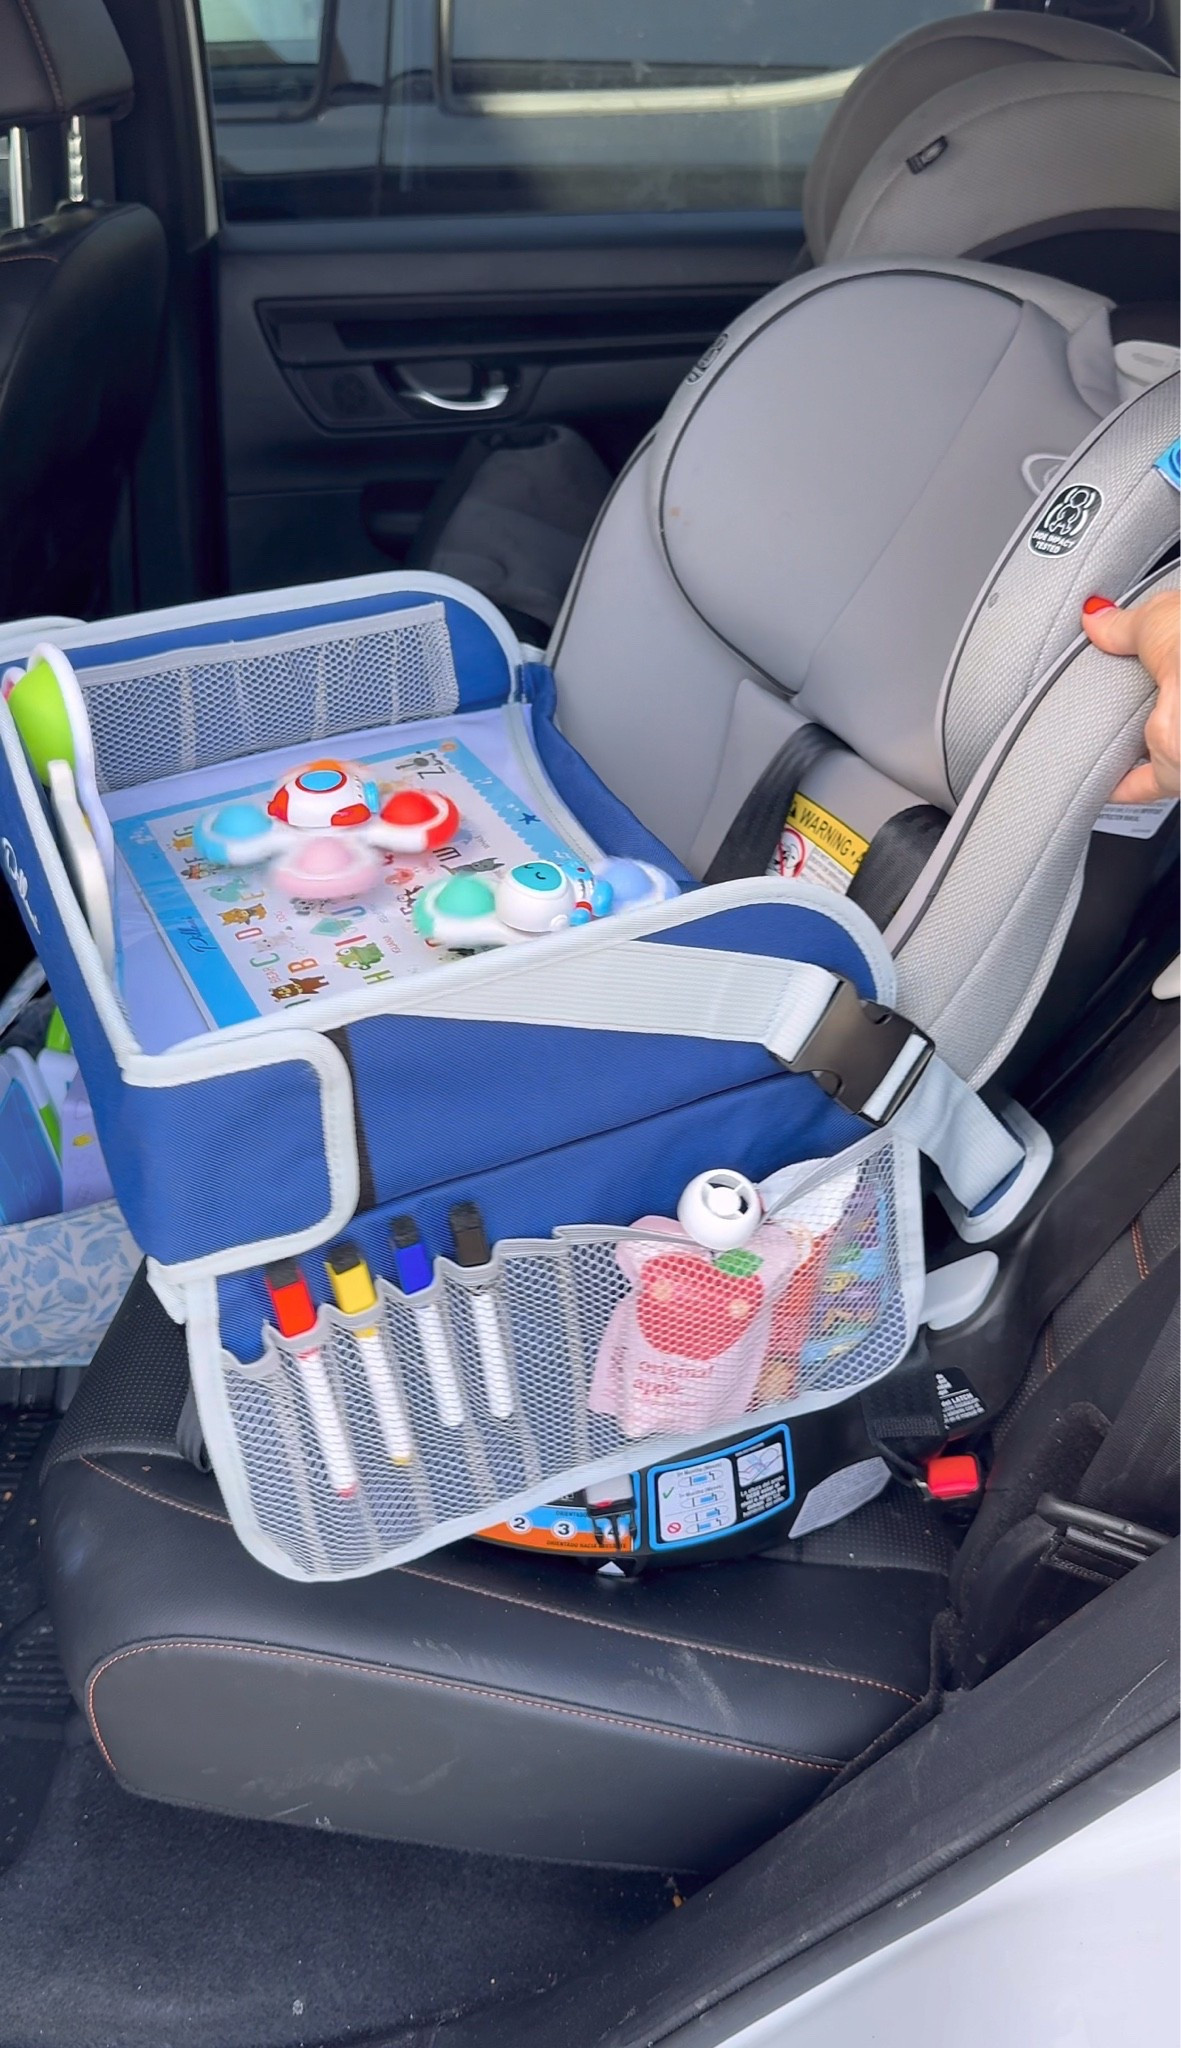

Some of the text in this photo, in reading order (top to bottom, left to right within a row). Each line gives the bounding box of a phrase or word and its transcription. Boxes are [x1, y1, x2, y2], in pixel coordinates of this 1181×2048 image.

[1033, 531, 1075, 549] SIDE IMPACT
[1034, 540, 1061, 554] TESTED
[799, 807, 852, 856] WARNING
[234, 927, 263, 941] D
[249, 952, 280, 968] C
[287, 957, 319, 973] B
[362, 969, 395, 985] H
[638, 1360, 715, 1381] original
[632, 1379, 684, 1397] apple
[513, 1516, 526, 1530] 2
[557, 1523, 570, 1536] 3
